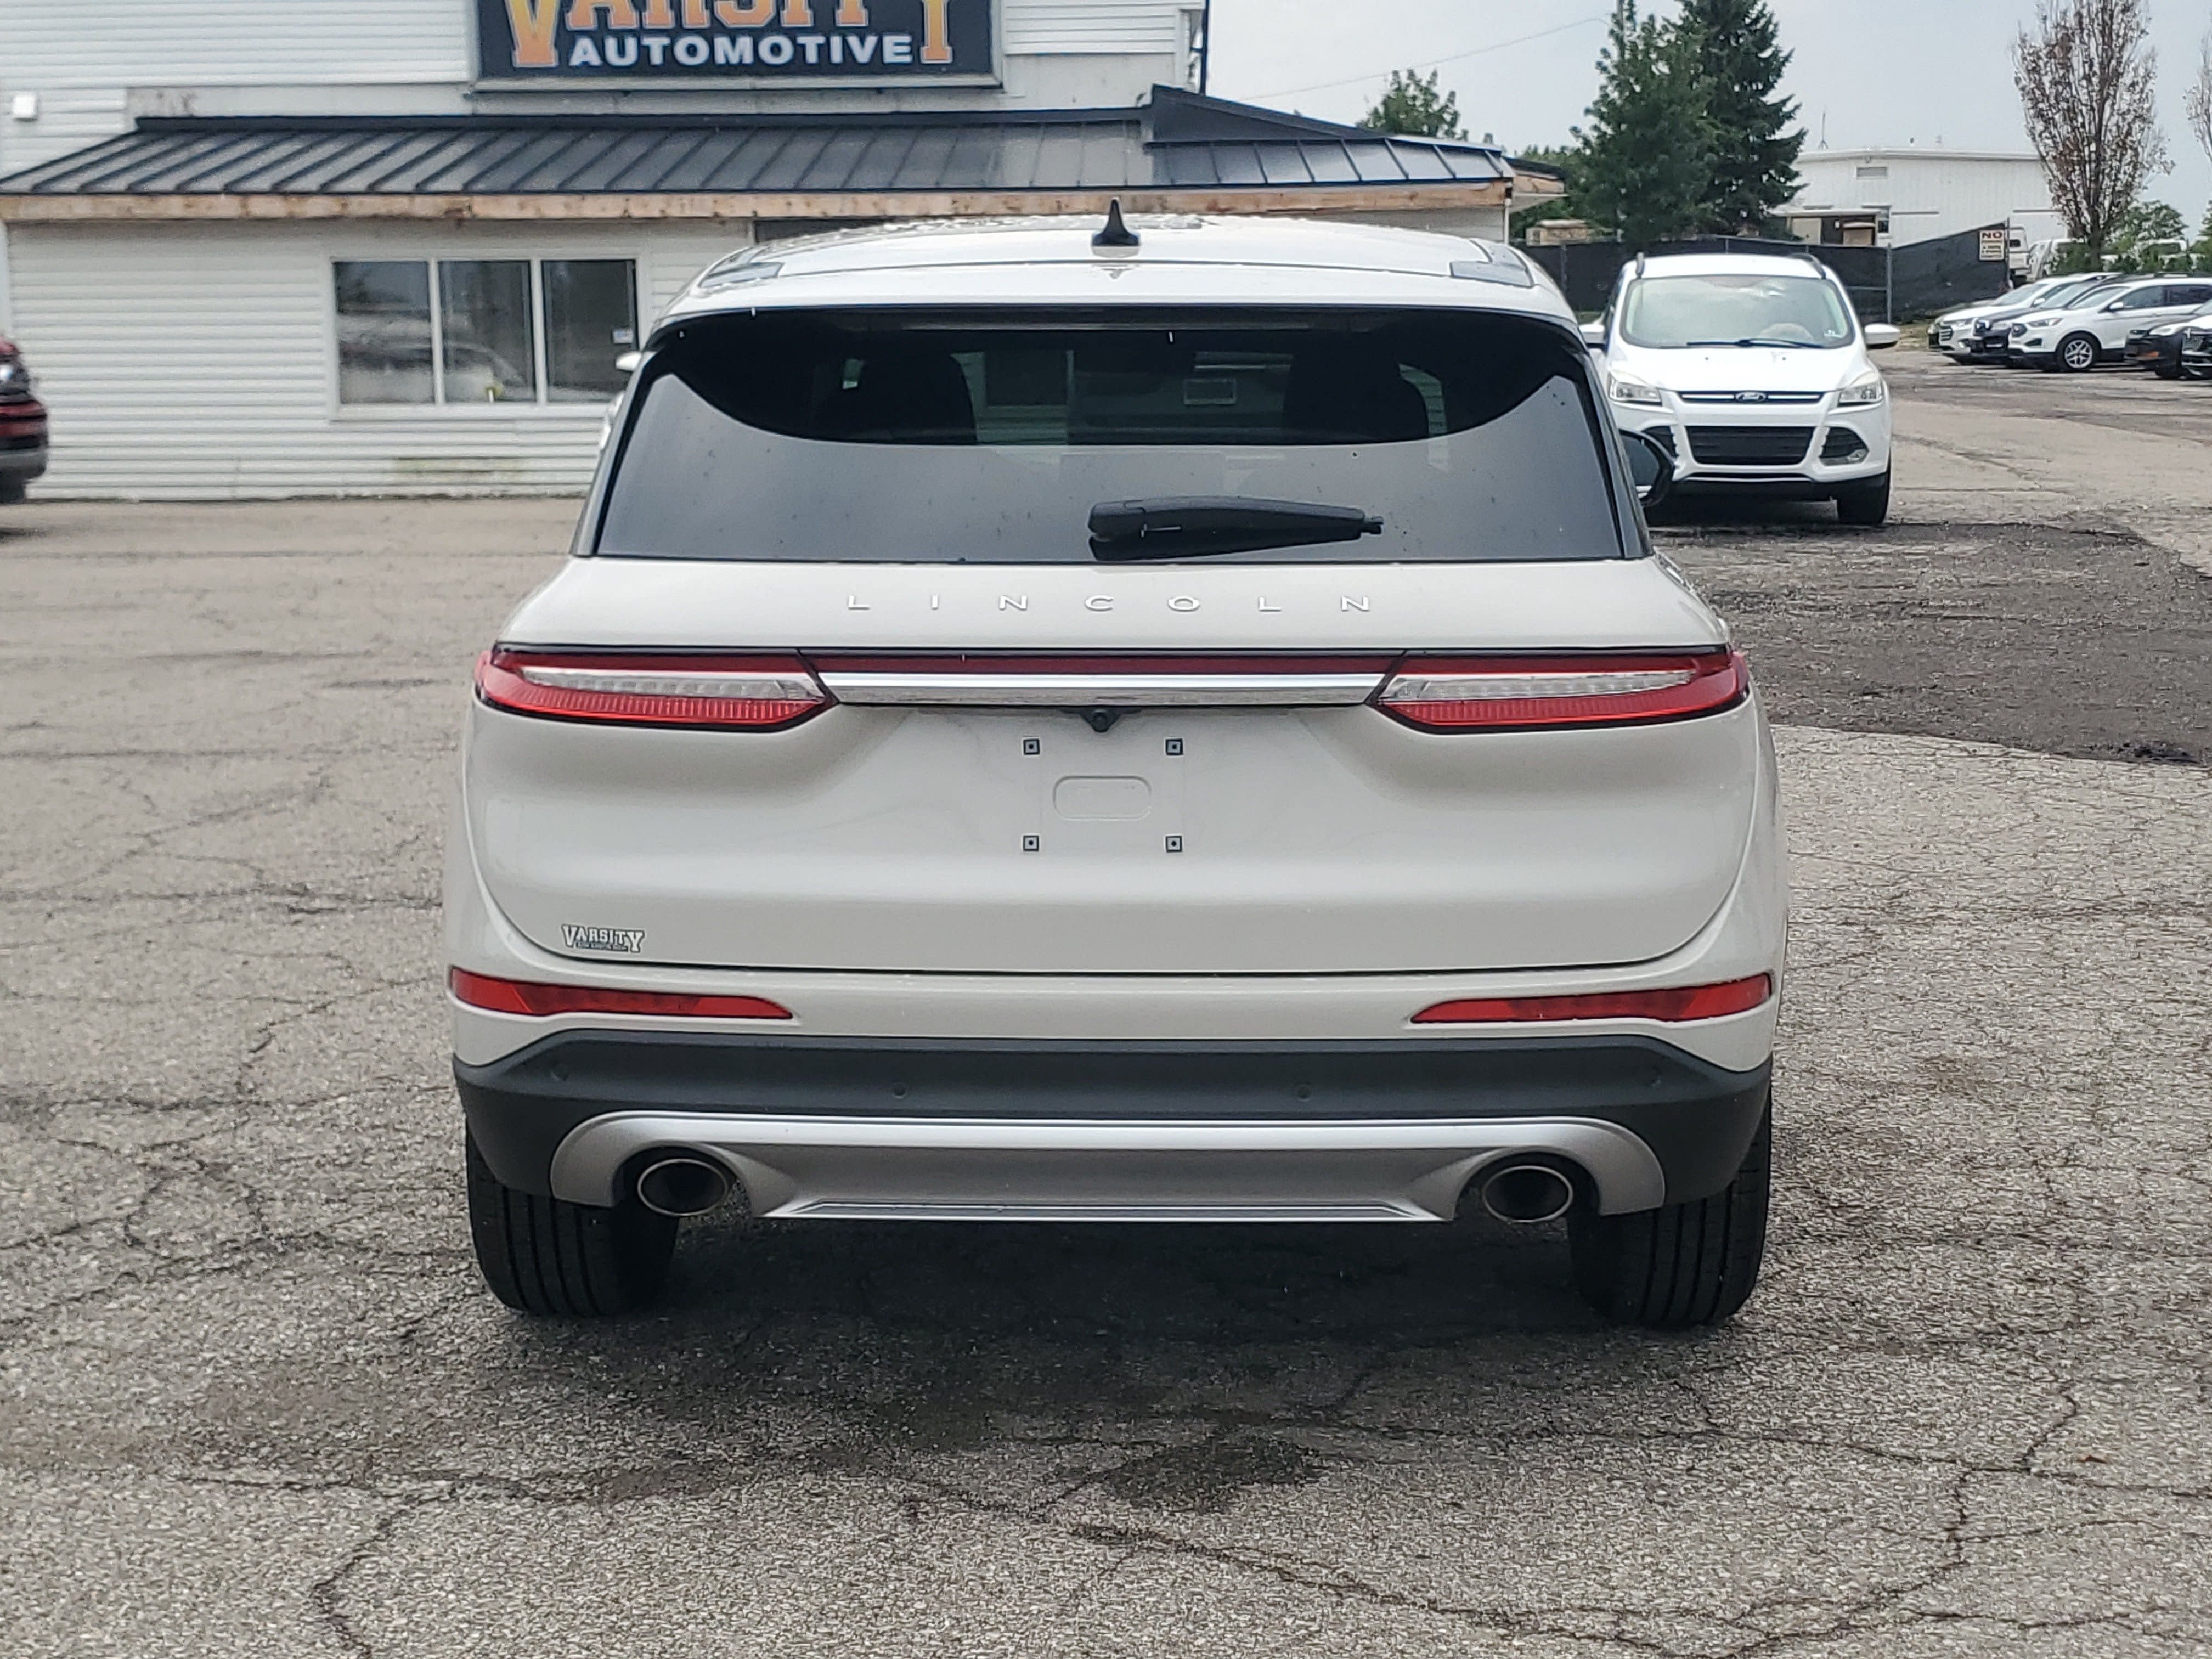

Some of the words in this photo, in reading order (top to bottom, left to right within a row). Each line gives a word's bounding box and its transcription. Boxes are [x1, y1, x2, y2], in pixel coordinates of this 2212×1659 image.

[568, 34, 913, 67] AUTOMOTIVE
[848, 595, 1370, 612] LINCOLN
[561, 925, 644, 952] VARSITY
